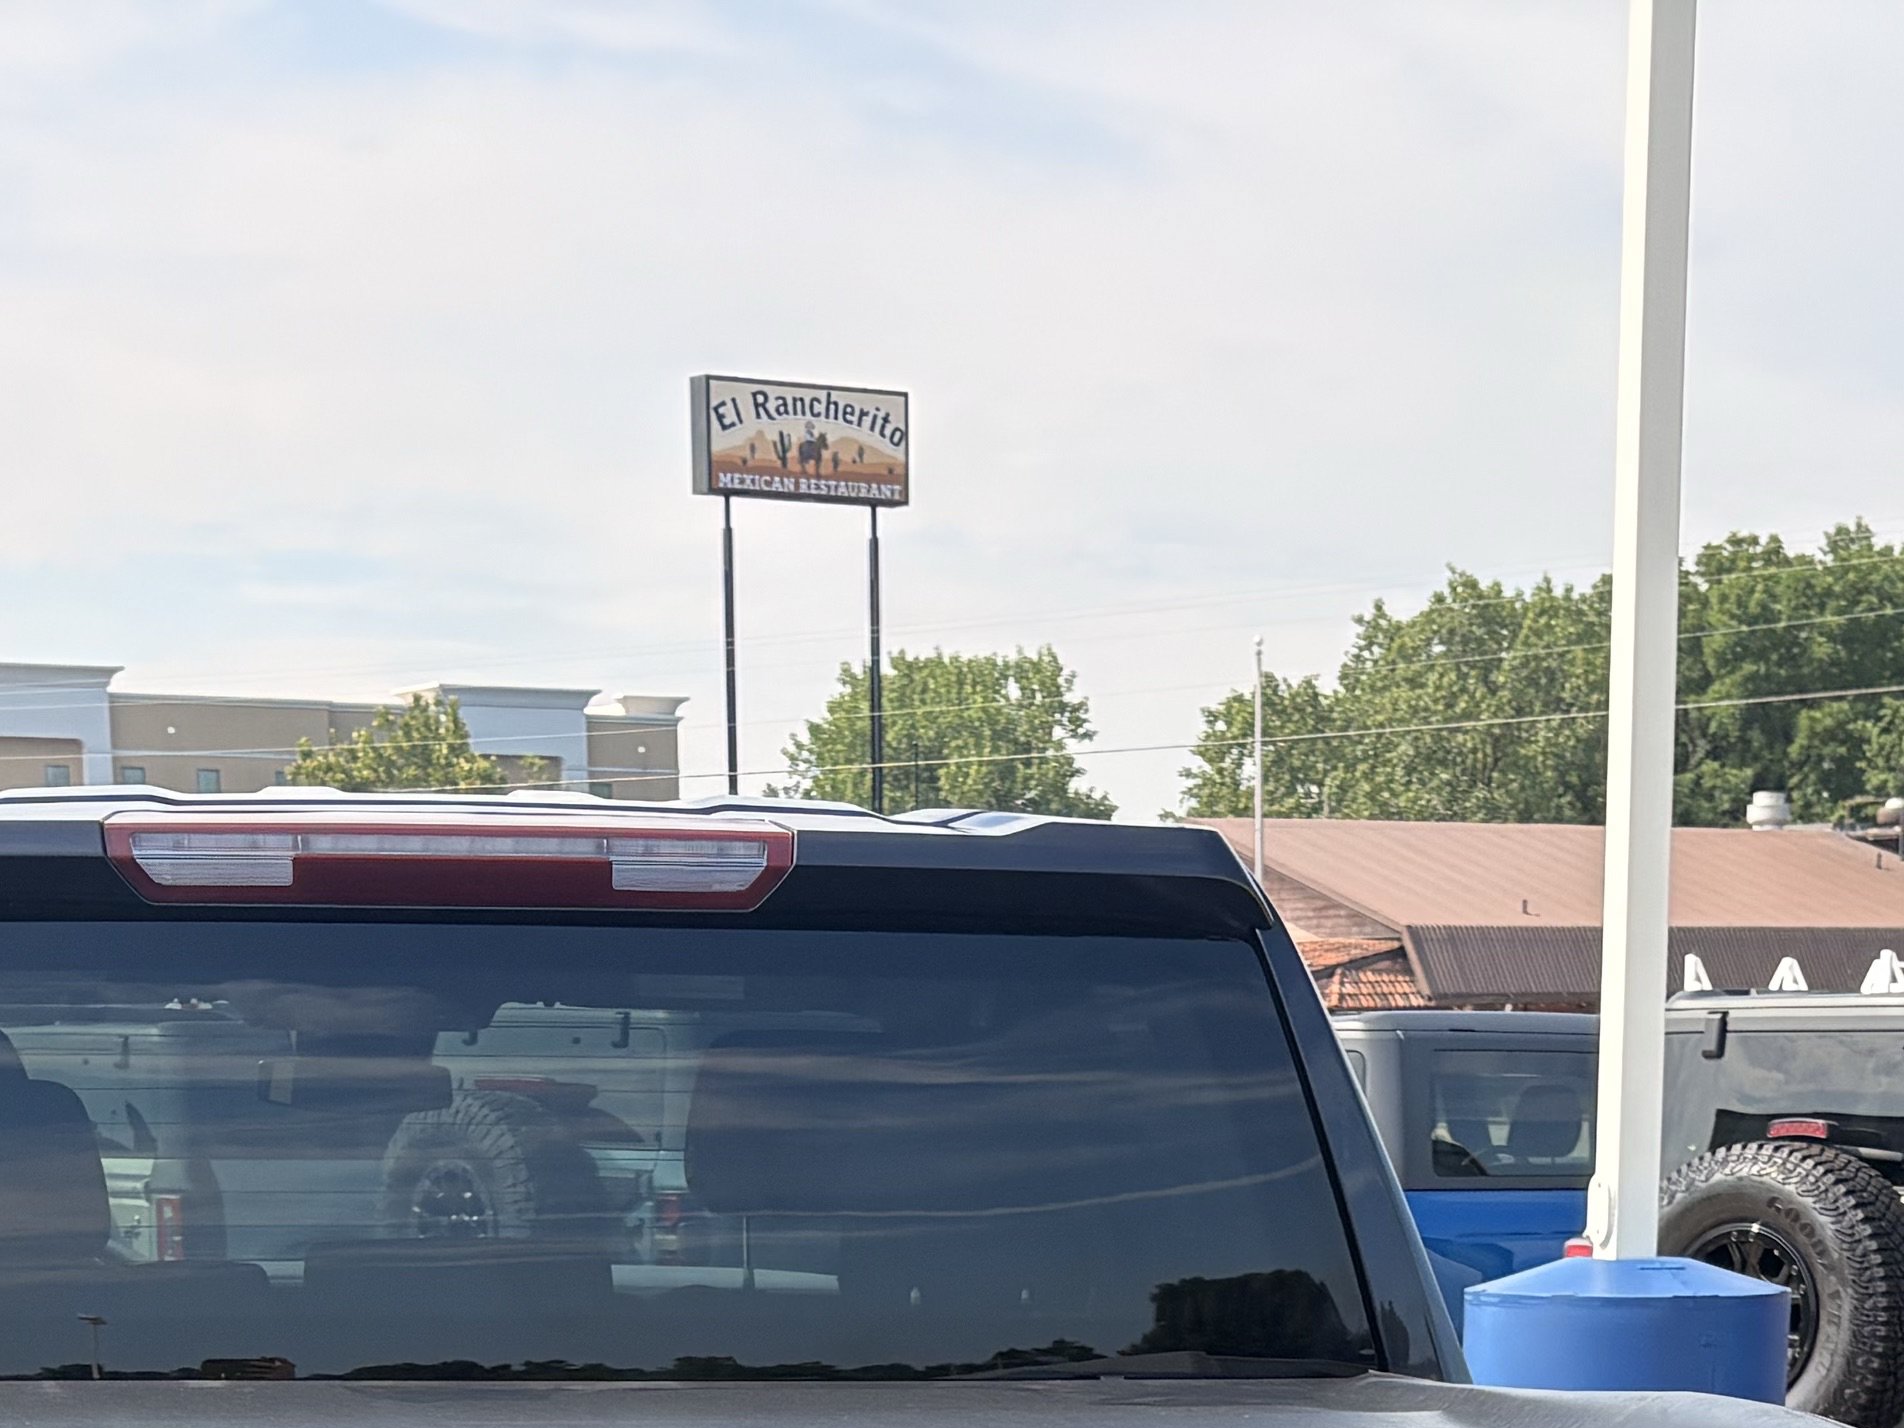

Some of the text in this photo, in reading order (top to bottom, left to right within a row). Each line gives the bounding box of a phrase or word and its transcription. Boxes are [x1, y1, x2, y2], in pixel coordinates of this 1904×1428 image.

[712, 390, 905, 448] El Rancherito
[718, 472, 904, 500] MEXICAN RESTAURANT
